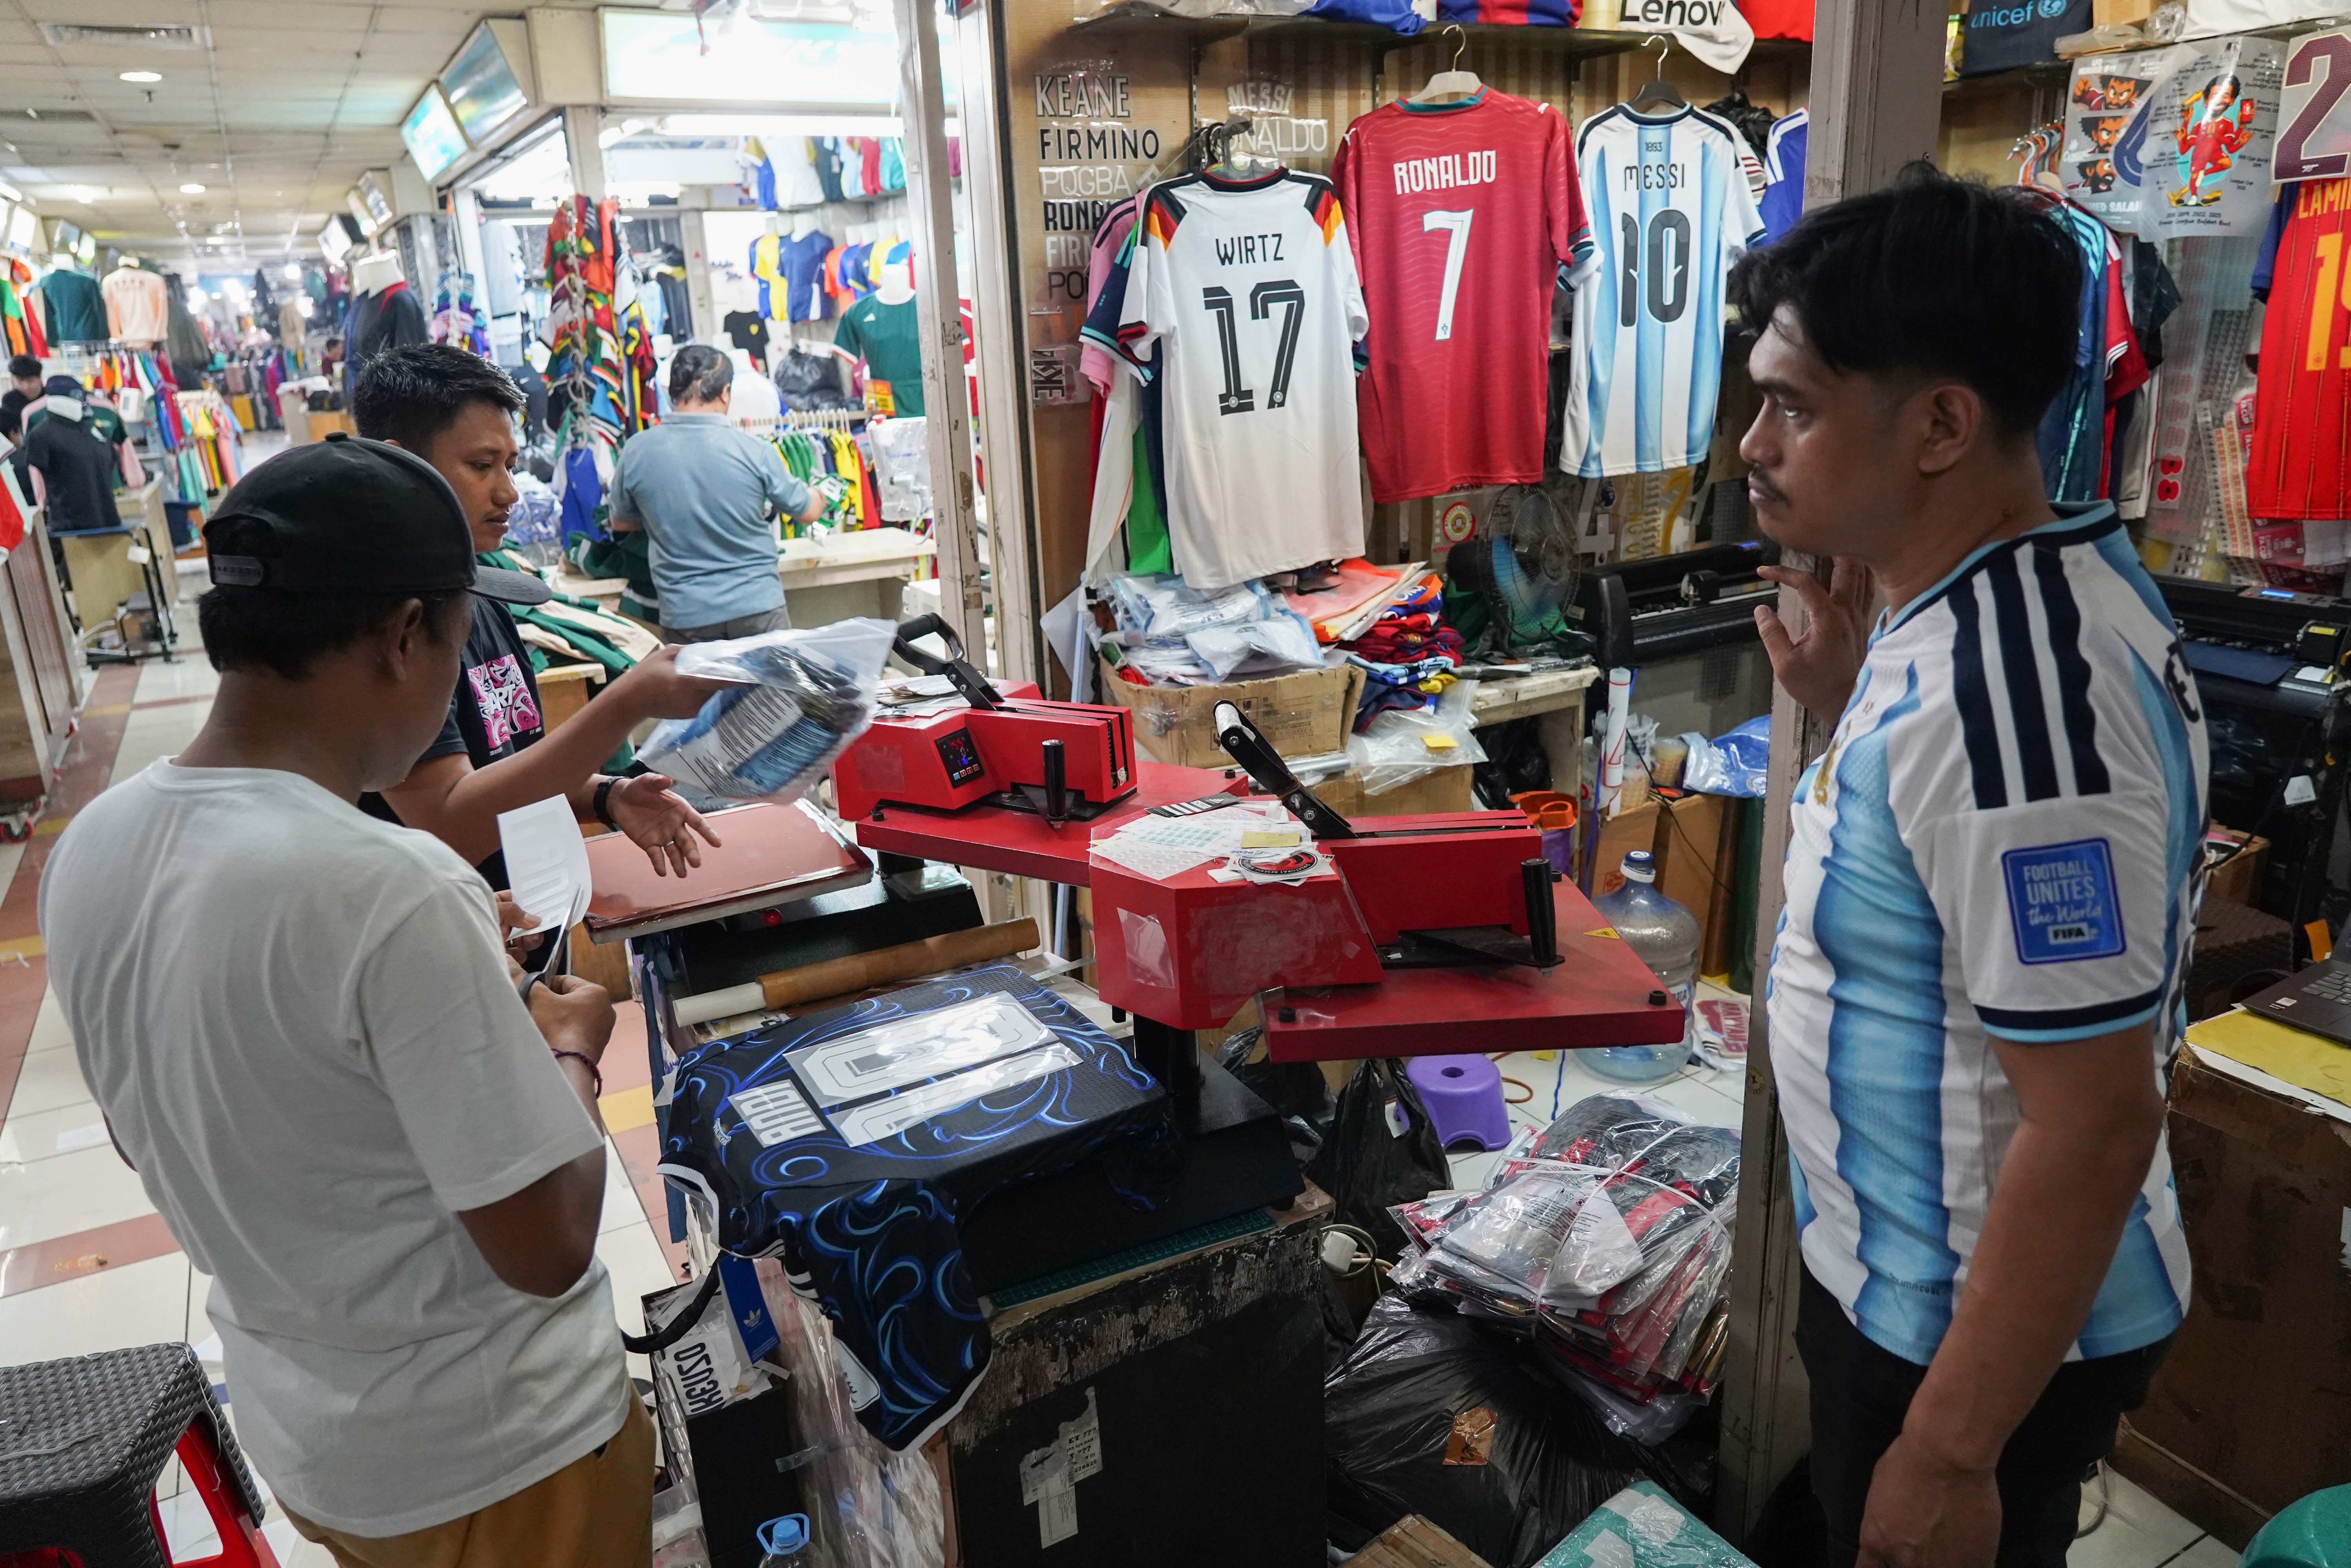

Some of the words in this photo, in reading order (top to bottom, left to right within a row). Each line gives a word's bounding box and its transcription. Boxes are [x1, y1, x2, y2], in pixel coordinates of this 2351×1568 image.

[1971, 2, 2033, 29] unicef
[1035, 75, 1130, 118] KEANE
[1228, 82, 1293, 114] MESSI
[2271, 32, 2351, 183] 2
[1040, 129, 1159, 159] FIRMINO
[1040, 165, 1132, 196] POGBA
[1393, 150, 1496, 195] RONALDO
[1625, 163, 1685, 192] MESSI
[1215, 233, 1284, 266] WIRTZ
[1423, 208, 1474, 341] 7
[1620, 209, 1691, 327] 10
[1202, 279, 1305, 416] 17
[488, 684, 516, 715] ART
[2023, 859, 2092, 882] FOOTBALL
[2026, 876, 2095, 904] UNITES
[2027, 906, 2055, 926] the
[2056, 900, 2102, 922] World
[2052, 926, 2085, 940] FIFA
